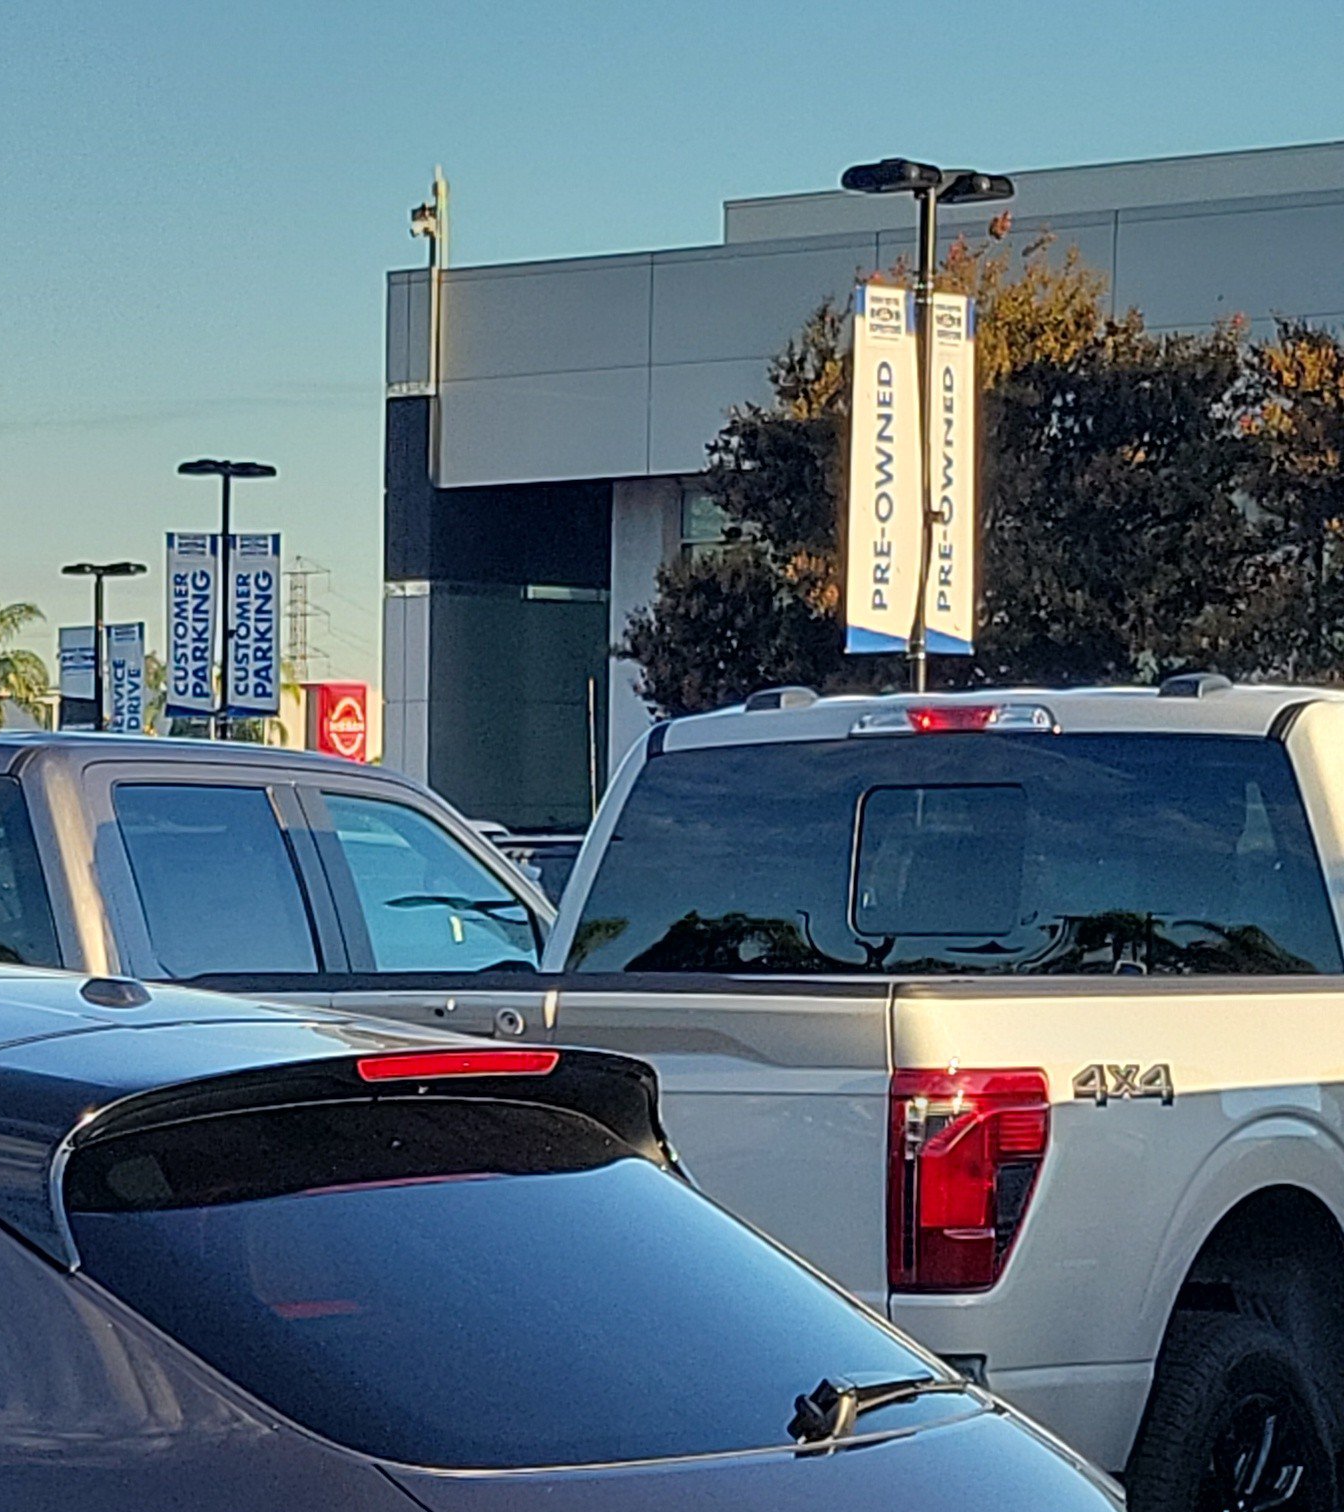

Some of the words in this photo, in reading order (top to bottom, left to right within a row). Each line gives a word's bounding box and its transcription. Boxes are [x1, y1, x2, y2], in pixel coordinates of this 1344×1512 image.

[871, 361, 894, 611] PRE-OWNED
[937, 365, 954, 613] PRE-OWNED
[174, 572, 189, 696] CUSTOMER
[191, 569, 211, 698] PARKING
[234, 573, 251, 696] CUSTOMER
[253, 570, 273, 698] PARKING
[127, 668, 141, 730] DRIVE
